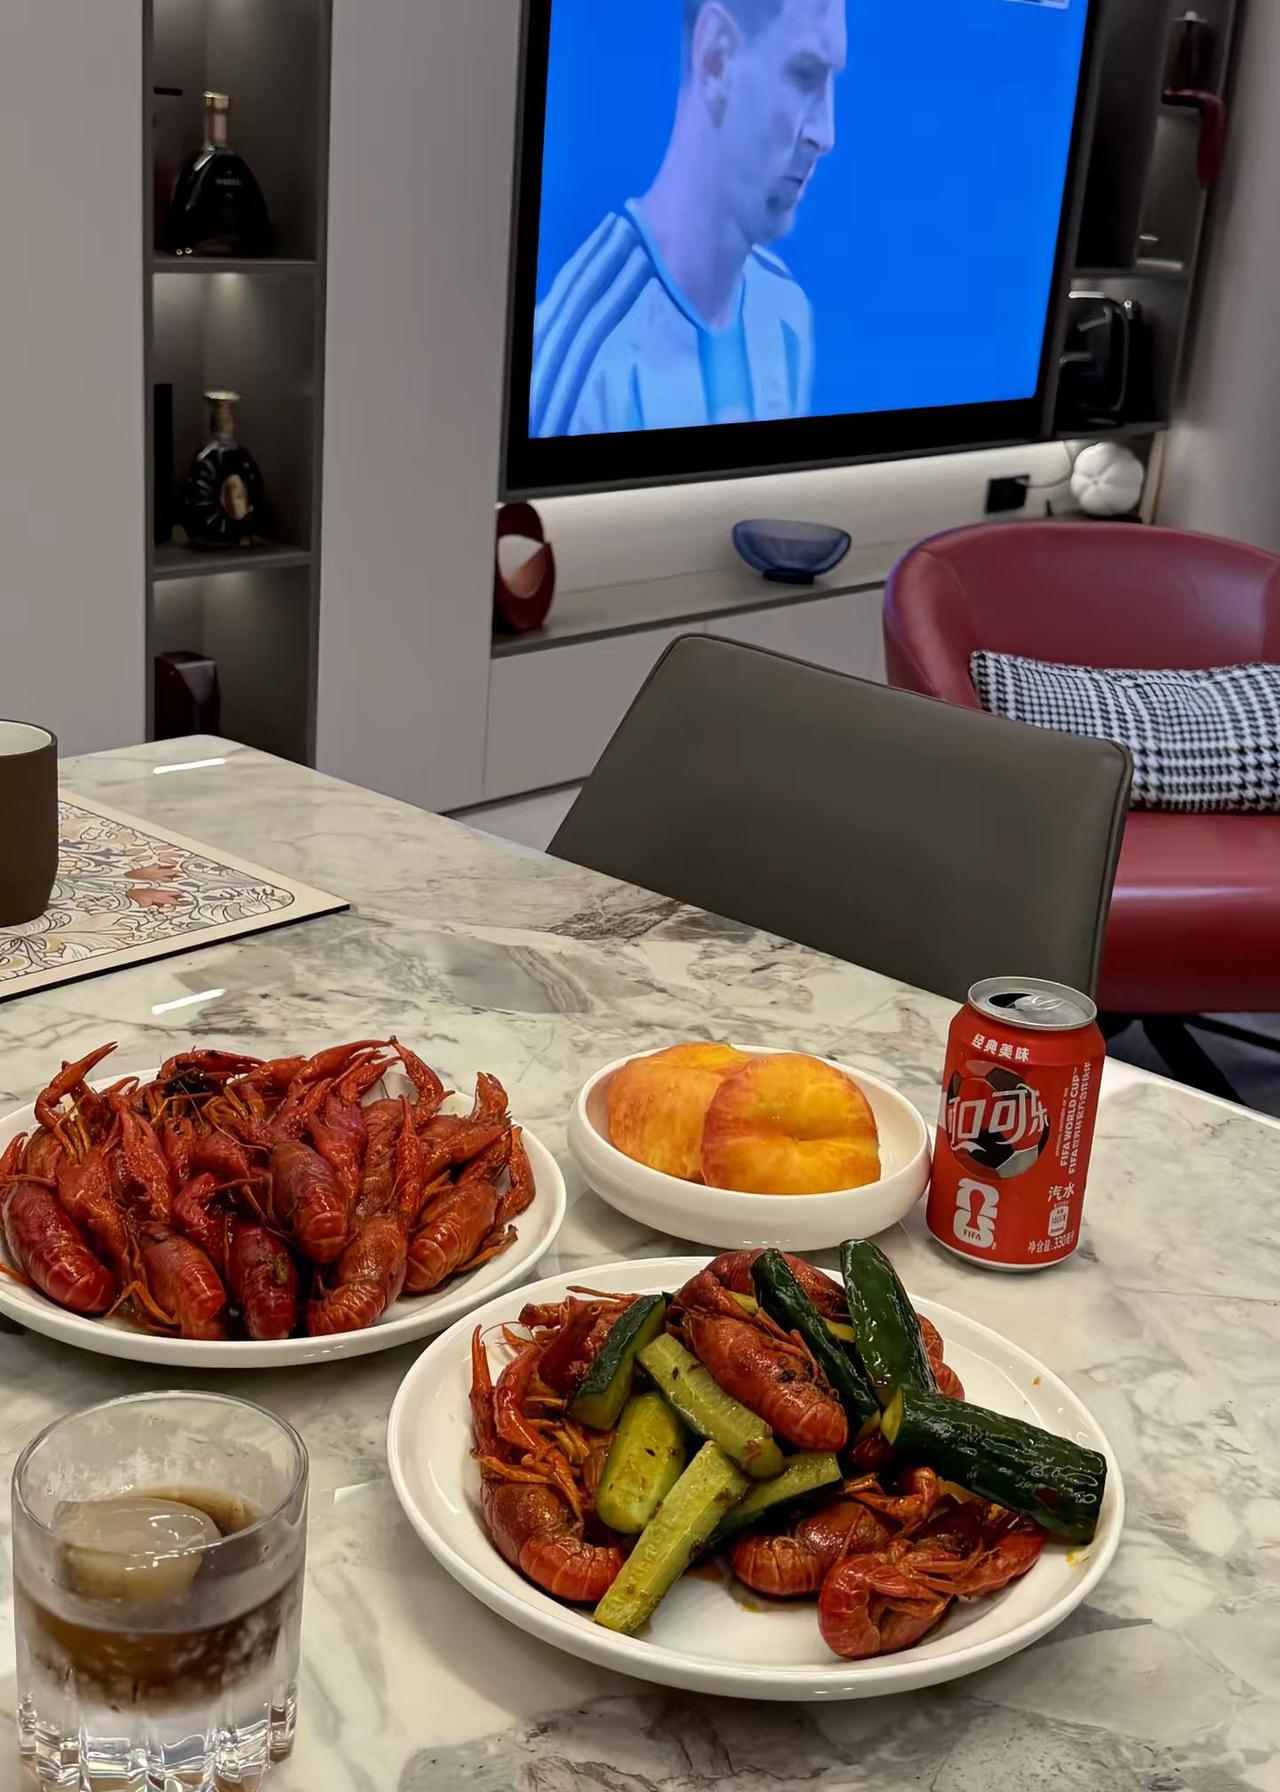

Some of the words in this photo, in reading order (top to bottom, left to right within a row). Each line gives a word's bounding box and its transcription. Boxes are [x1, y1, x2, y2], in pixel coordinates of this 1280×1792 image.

[971, 1033, 1030, 1062] 经典美味
[1063, 1099, 1077, 1141] WORLD
[1060, 1141, 1071, 1167] FIFA
[1048, 1182, 1075, 1202] 汽水
[964, 1228, 982, 1241] FIFA
